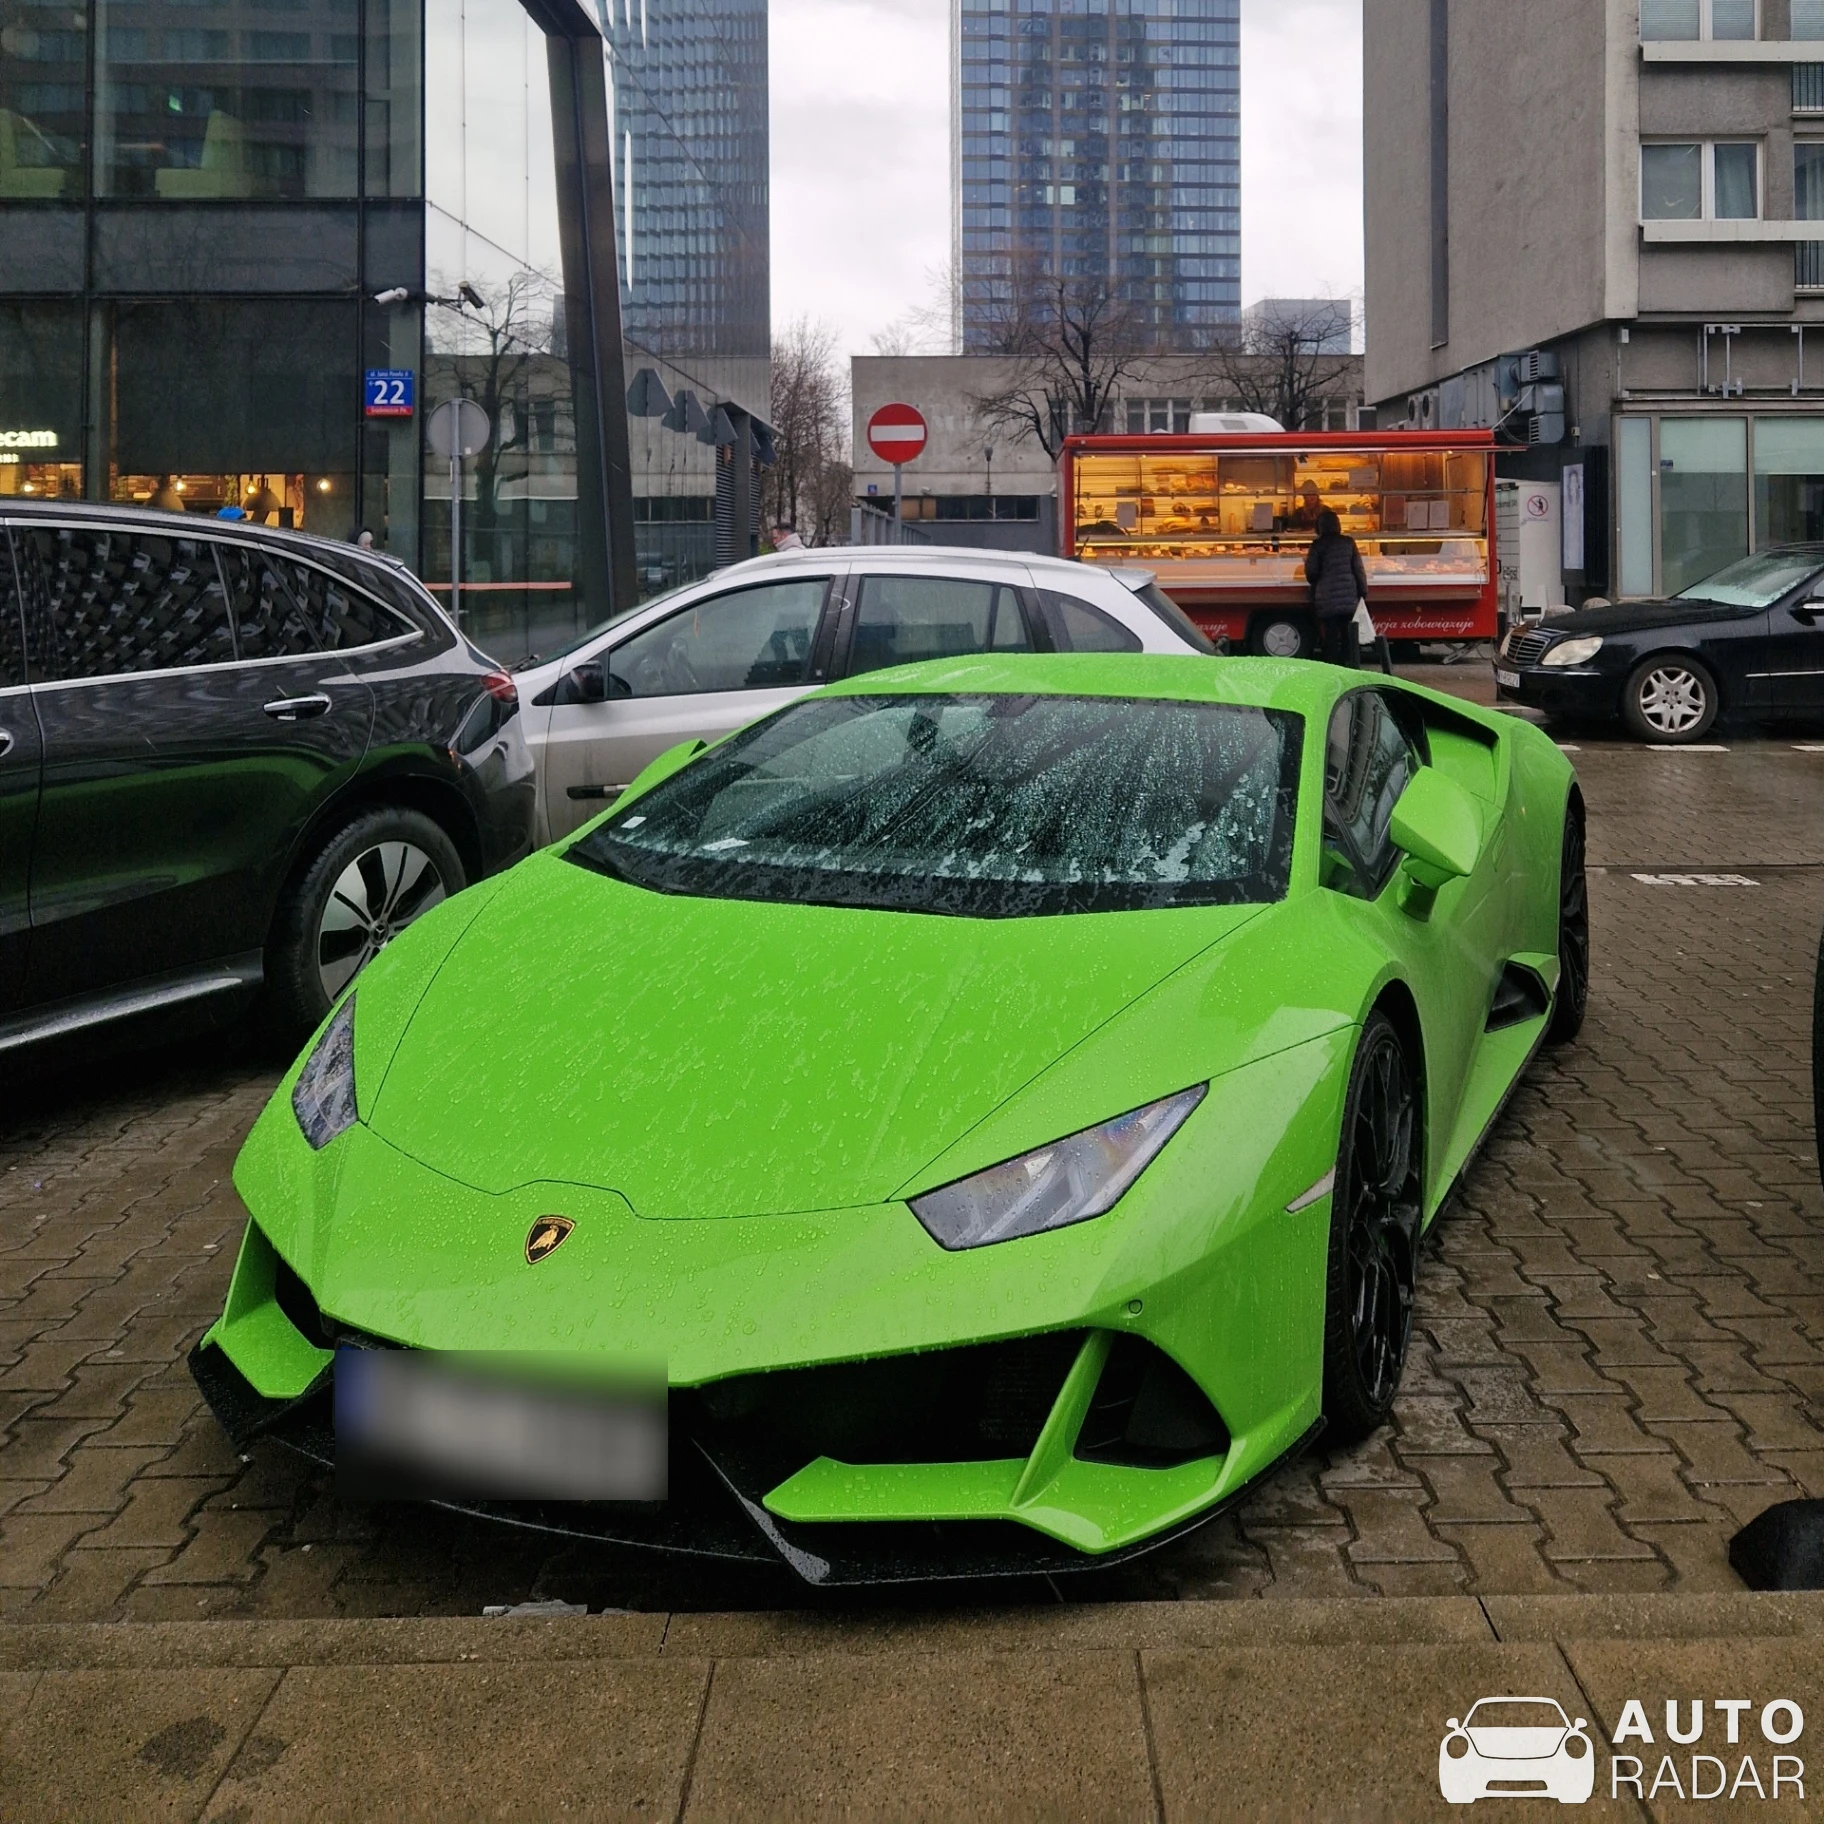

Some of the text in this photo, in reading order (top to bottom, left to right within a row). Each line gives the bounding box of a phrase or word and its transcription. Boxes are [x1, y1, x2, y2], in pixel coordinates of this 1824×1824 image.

[374, 380, 404, 404] 22
[1372, 616, 1475, 634] ycja zobowiązuje
